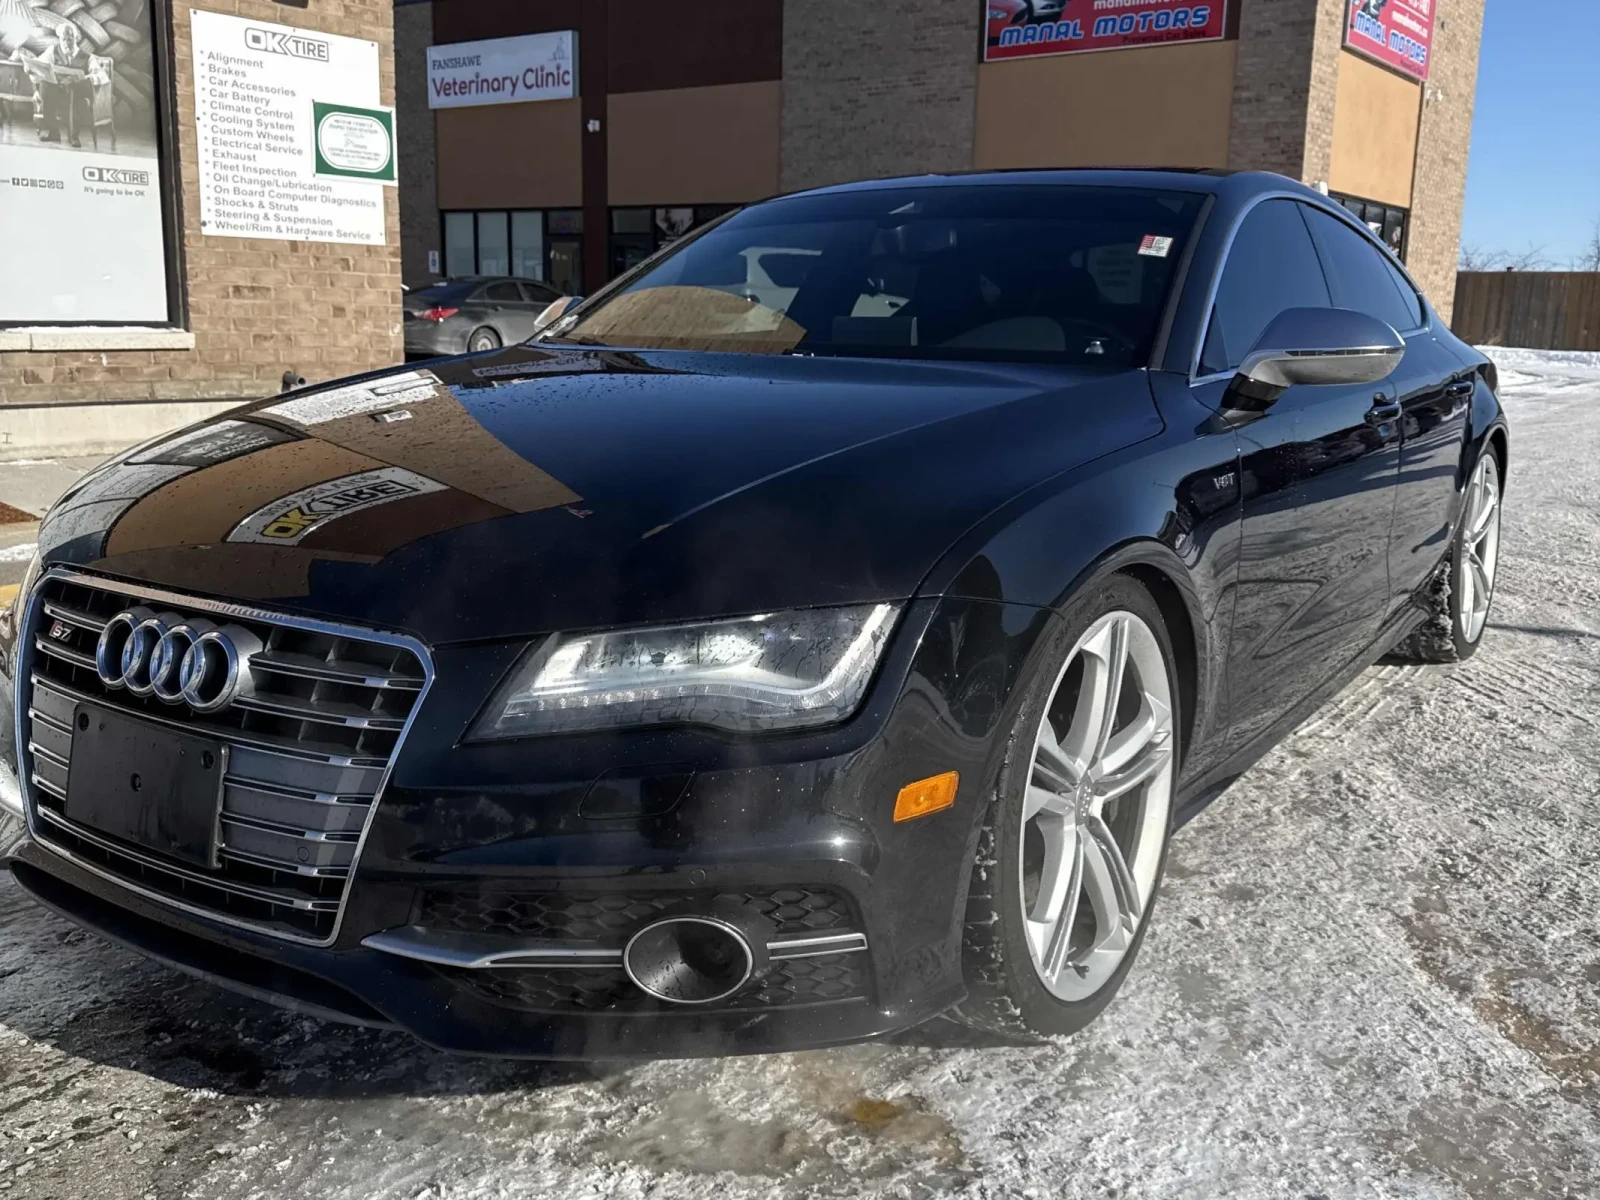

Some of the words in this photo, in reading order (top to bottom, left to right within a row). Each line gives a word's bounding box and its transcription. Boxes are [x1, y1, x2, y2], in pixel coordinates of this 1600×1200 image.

[1000, 18, 1084, 47] MANAL
[1092, 5, 1210, 37] MOTORS
[1353, 10, 1387, 47] MANAL
[207, 51, 264, 69] Alignment
[432, 55, 482, 71] FANSHAWE
[208, 63, 247, 78] Brakes
[432, 72, 520, 97] Veterinary
[523, 63, 571, 90] Clinic
[208, 76, 228, 87] Car
[231, 80, 297, 97] Accessories
[209, 88, 229, 99] Car
[232, 91, 271, 107] Battery
[210, 100, 252, 114] Climate
[254, 106, 294, 120] Control
[210, 112, 253, 128] Cooling
[256, 118, 295, 131] System
[211, 124, 254, 138] Custom
[256, 130, 295, 143] Wheels
[211, 136, 262, 151] Electrical
[265, 143, 303, 156] Service
[212, 149, 257, 162] Exhaust
[212, 161, 240, 172] Fleet
[243, 164, 297, 178] Inspection
[84, 185, 94, 194] It's
[95, 187, 115, 197] going
[125, 188, 133, 196] be
[134, 189, 146, 197] OK
[213, 172, 229, 183] Oil
[232, 174, 332, 193] Change/Lubrication
[213, 184, 230, 195] On
[233, 186, 265, 198] Board
[268, 190, 318, 204] Computer
[320, 195, 377, 209] Diagnostics
[214, 196, 254, 209] Shocks
[257, 201, 266, 210] &
[269, 202, 299, 213] Struts
[214, 208, 260, 222] Steering
[262, 212, 271, 221] &
[273, 213, 333, 227] Suspension
[215, 220, 273, 233] Wheel/Rim
[275, 224, 283, 233] &
[286, 226, 333, 238] Hardware
[336, 230, 371, 241] Service
[51, 622, 74, 641] S7
